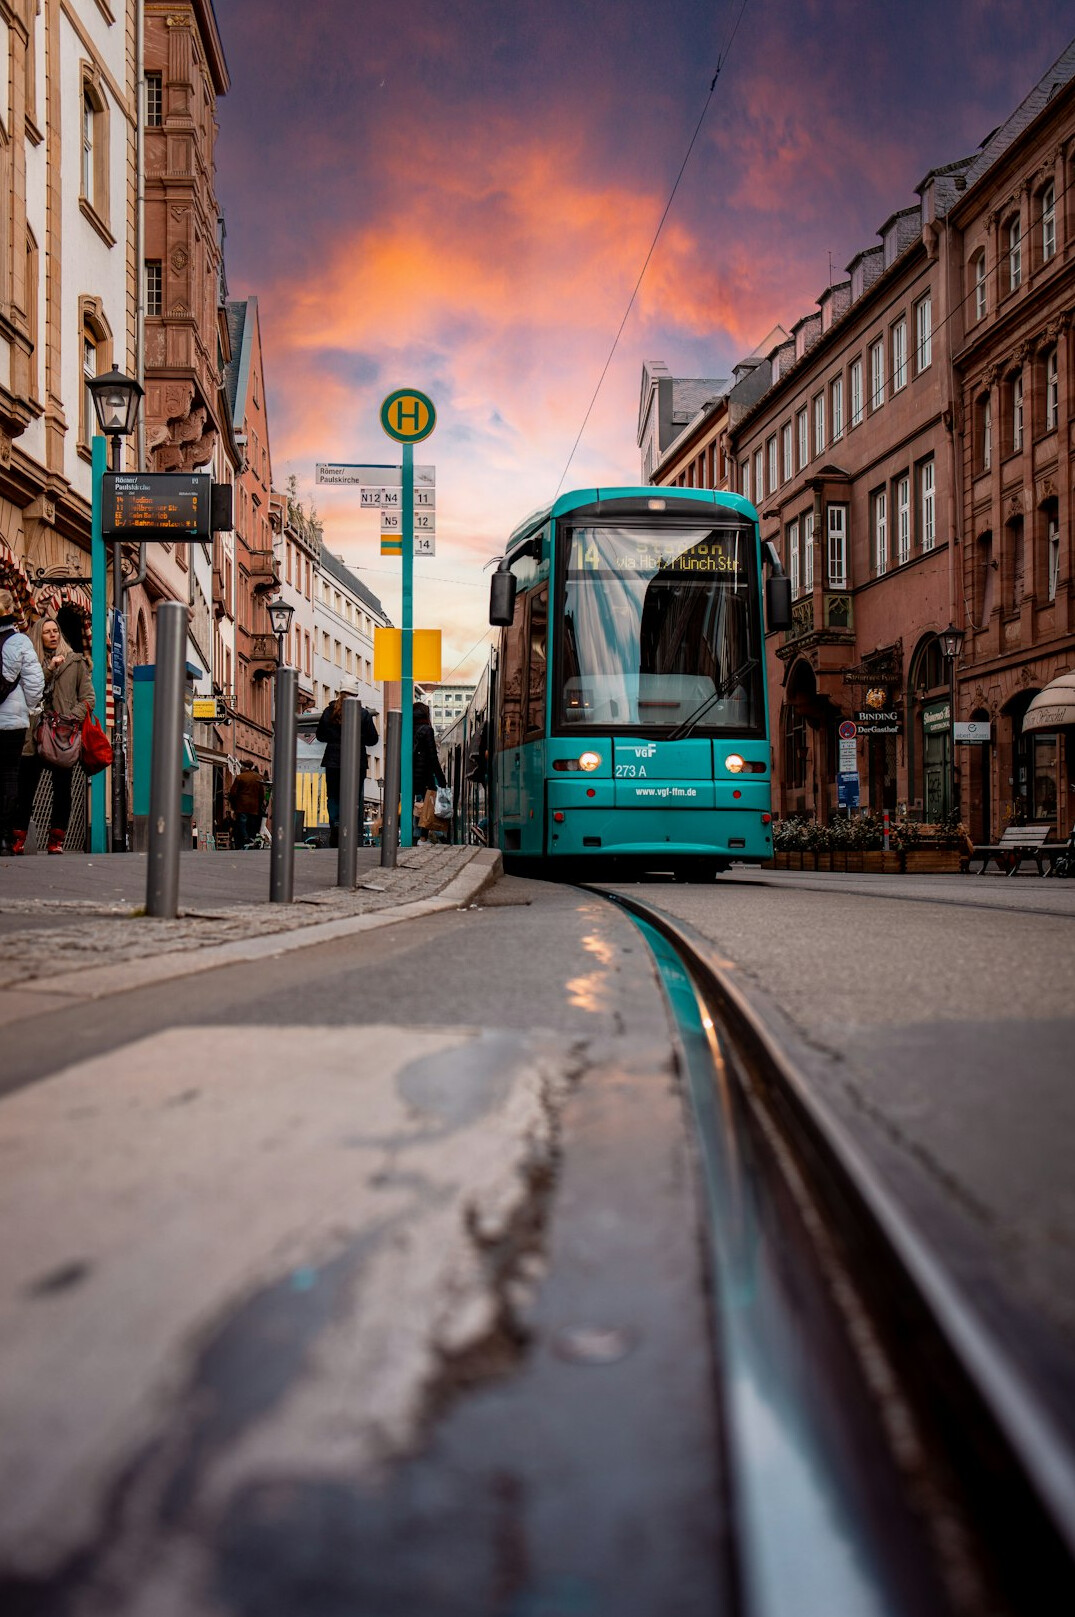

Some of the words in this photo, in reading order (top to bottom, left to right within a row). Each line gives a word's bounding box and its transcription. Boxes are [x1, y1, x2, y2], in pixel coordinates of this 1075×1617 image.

[397, 401, 419, 430] H
[320, 467, 345, 475] Römer/
[115, 476, 138, 484] Römer/
[320, 476, 360, 484] Paulskirche
[361, 493, 380, 503] N12
[385, 493, 398, 503] N4
[417, 493, 428, 503] 11
[385, 516, 398, 526] N5
[417, 517, 428, 527] 12
[418, 540, 430, 549] 14
[573, 543, 600, 570] 14
[859, 711, 898, 721] BINDING
[635, 743, 656, 758] VGF
[615, 764, 636, 777] 273
[638, 765, 647, 777] A
[636, 787, 697, 798] www.vgf-ffm.de
